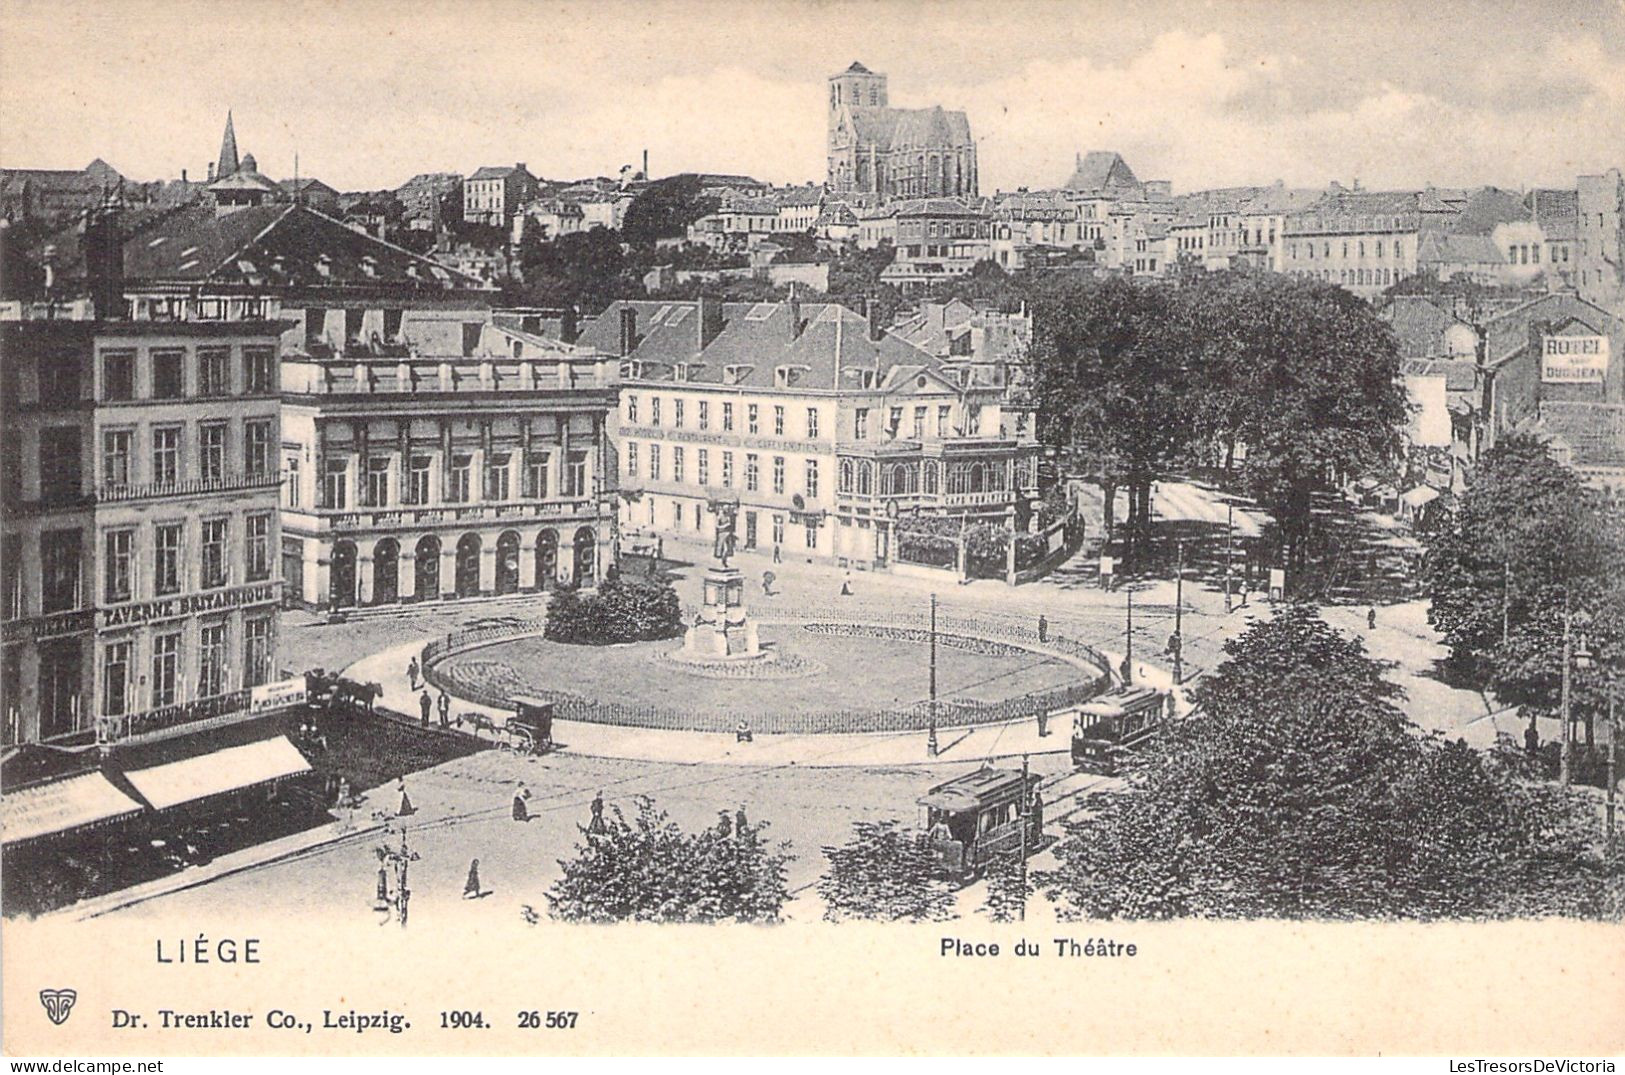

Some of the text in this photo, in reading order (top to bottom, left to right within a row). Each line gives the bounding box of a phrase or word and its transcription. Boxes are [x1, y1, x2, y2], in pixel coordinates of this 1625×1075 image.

[1547, 340, 1605, 355] HOTEL
[104, 600, 173, 627] TAVERNE
[180, 586, 273, 615] BRITANNIQUE
